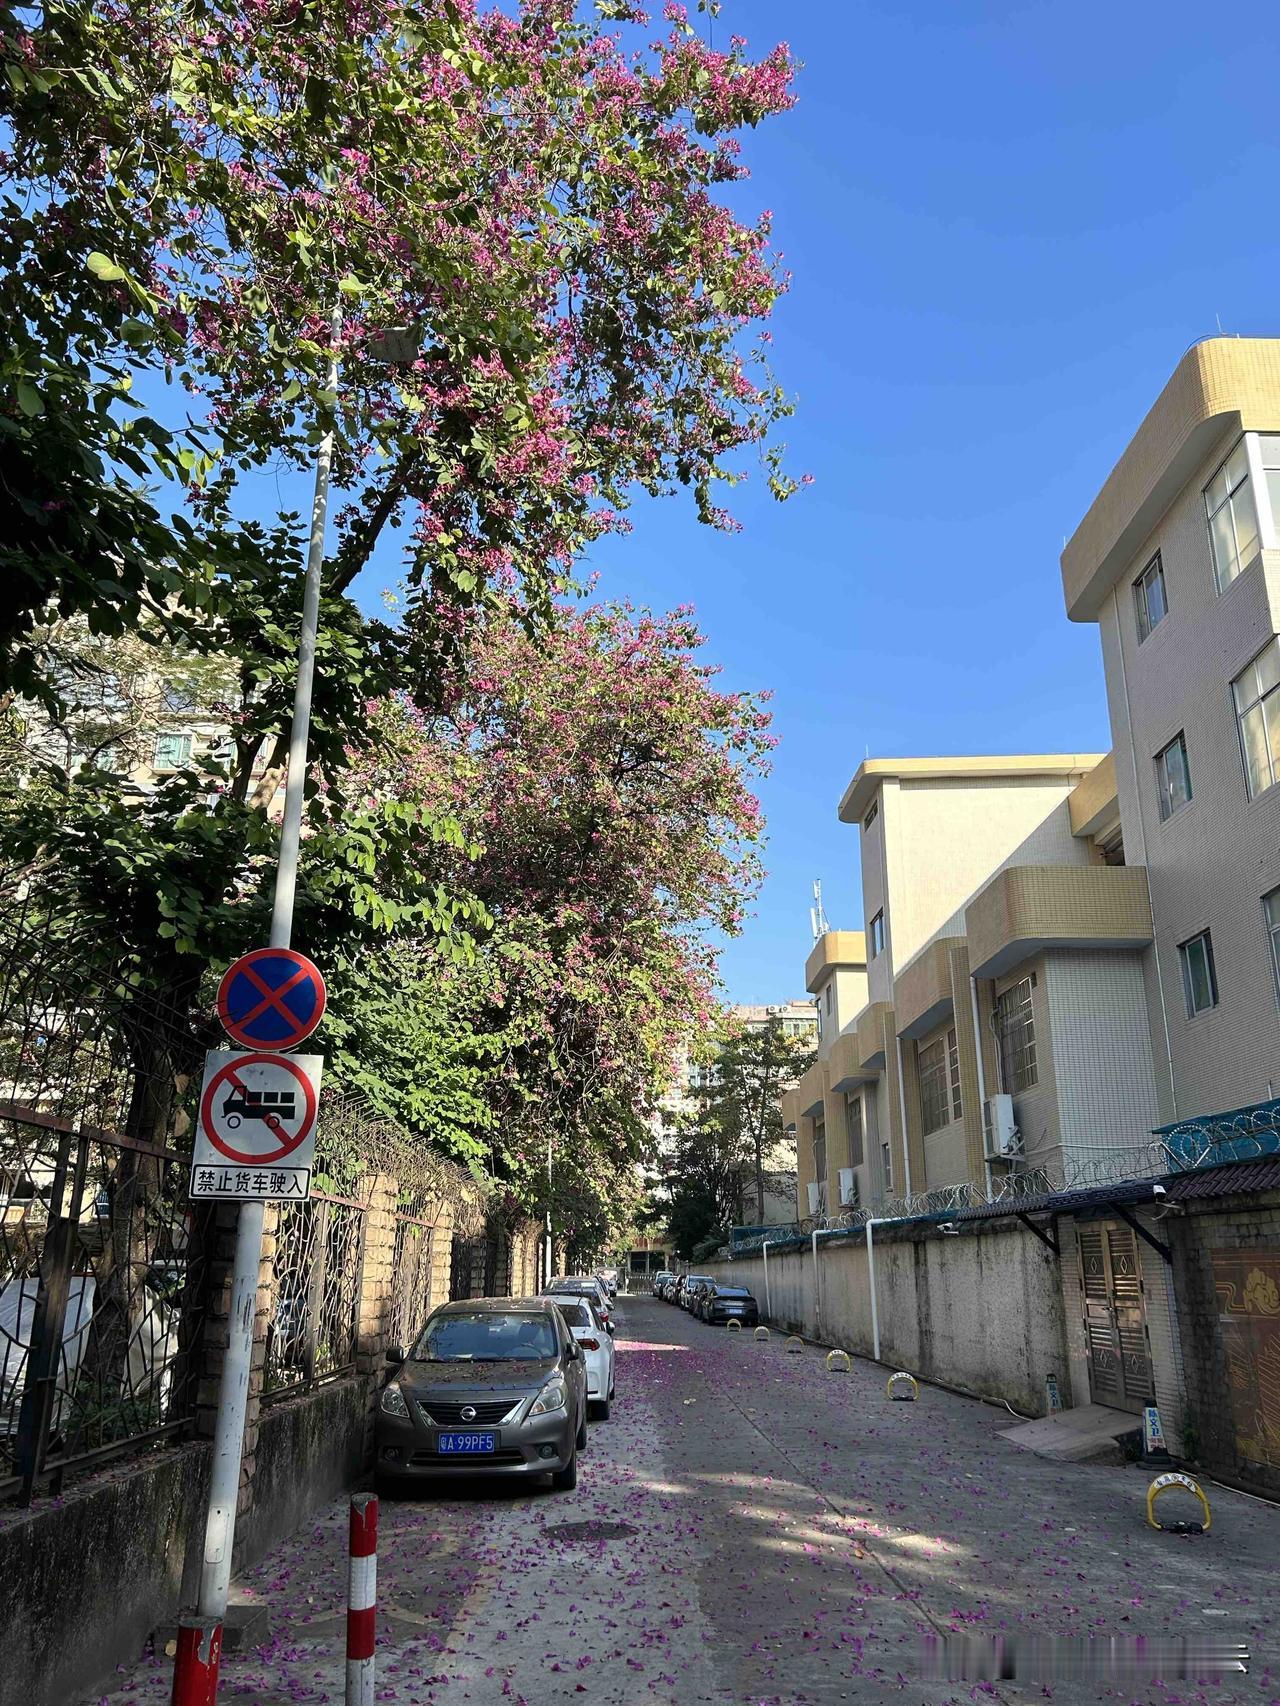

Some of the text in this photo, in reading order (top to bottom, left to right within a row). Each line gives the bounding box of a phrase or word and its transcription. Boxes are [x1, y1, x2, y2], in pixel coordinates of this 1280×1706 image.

[197, 1169, 303, 1194] 禁止货车驶入
